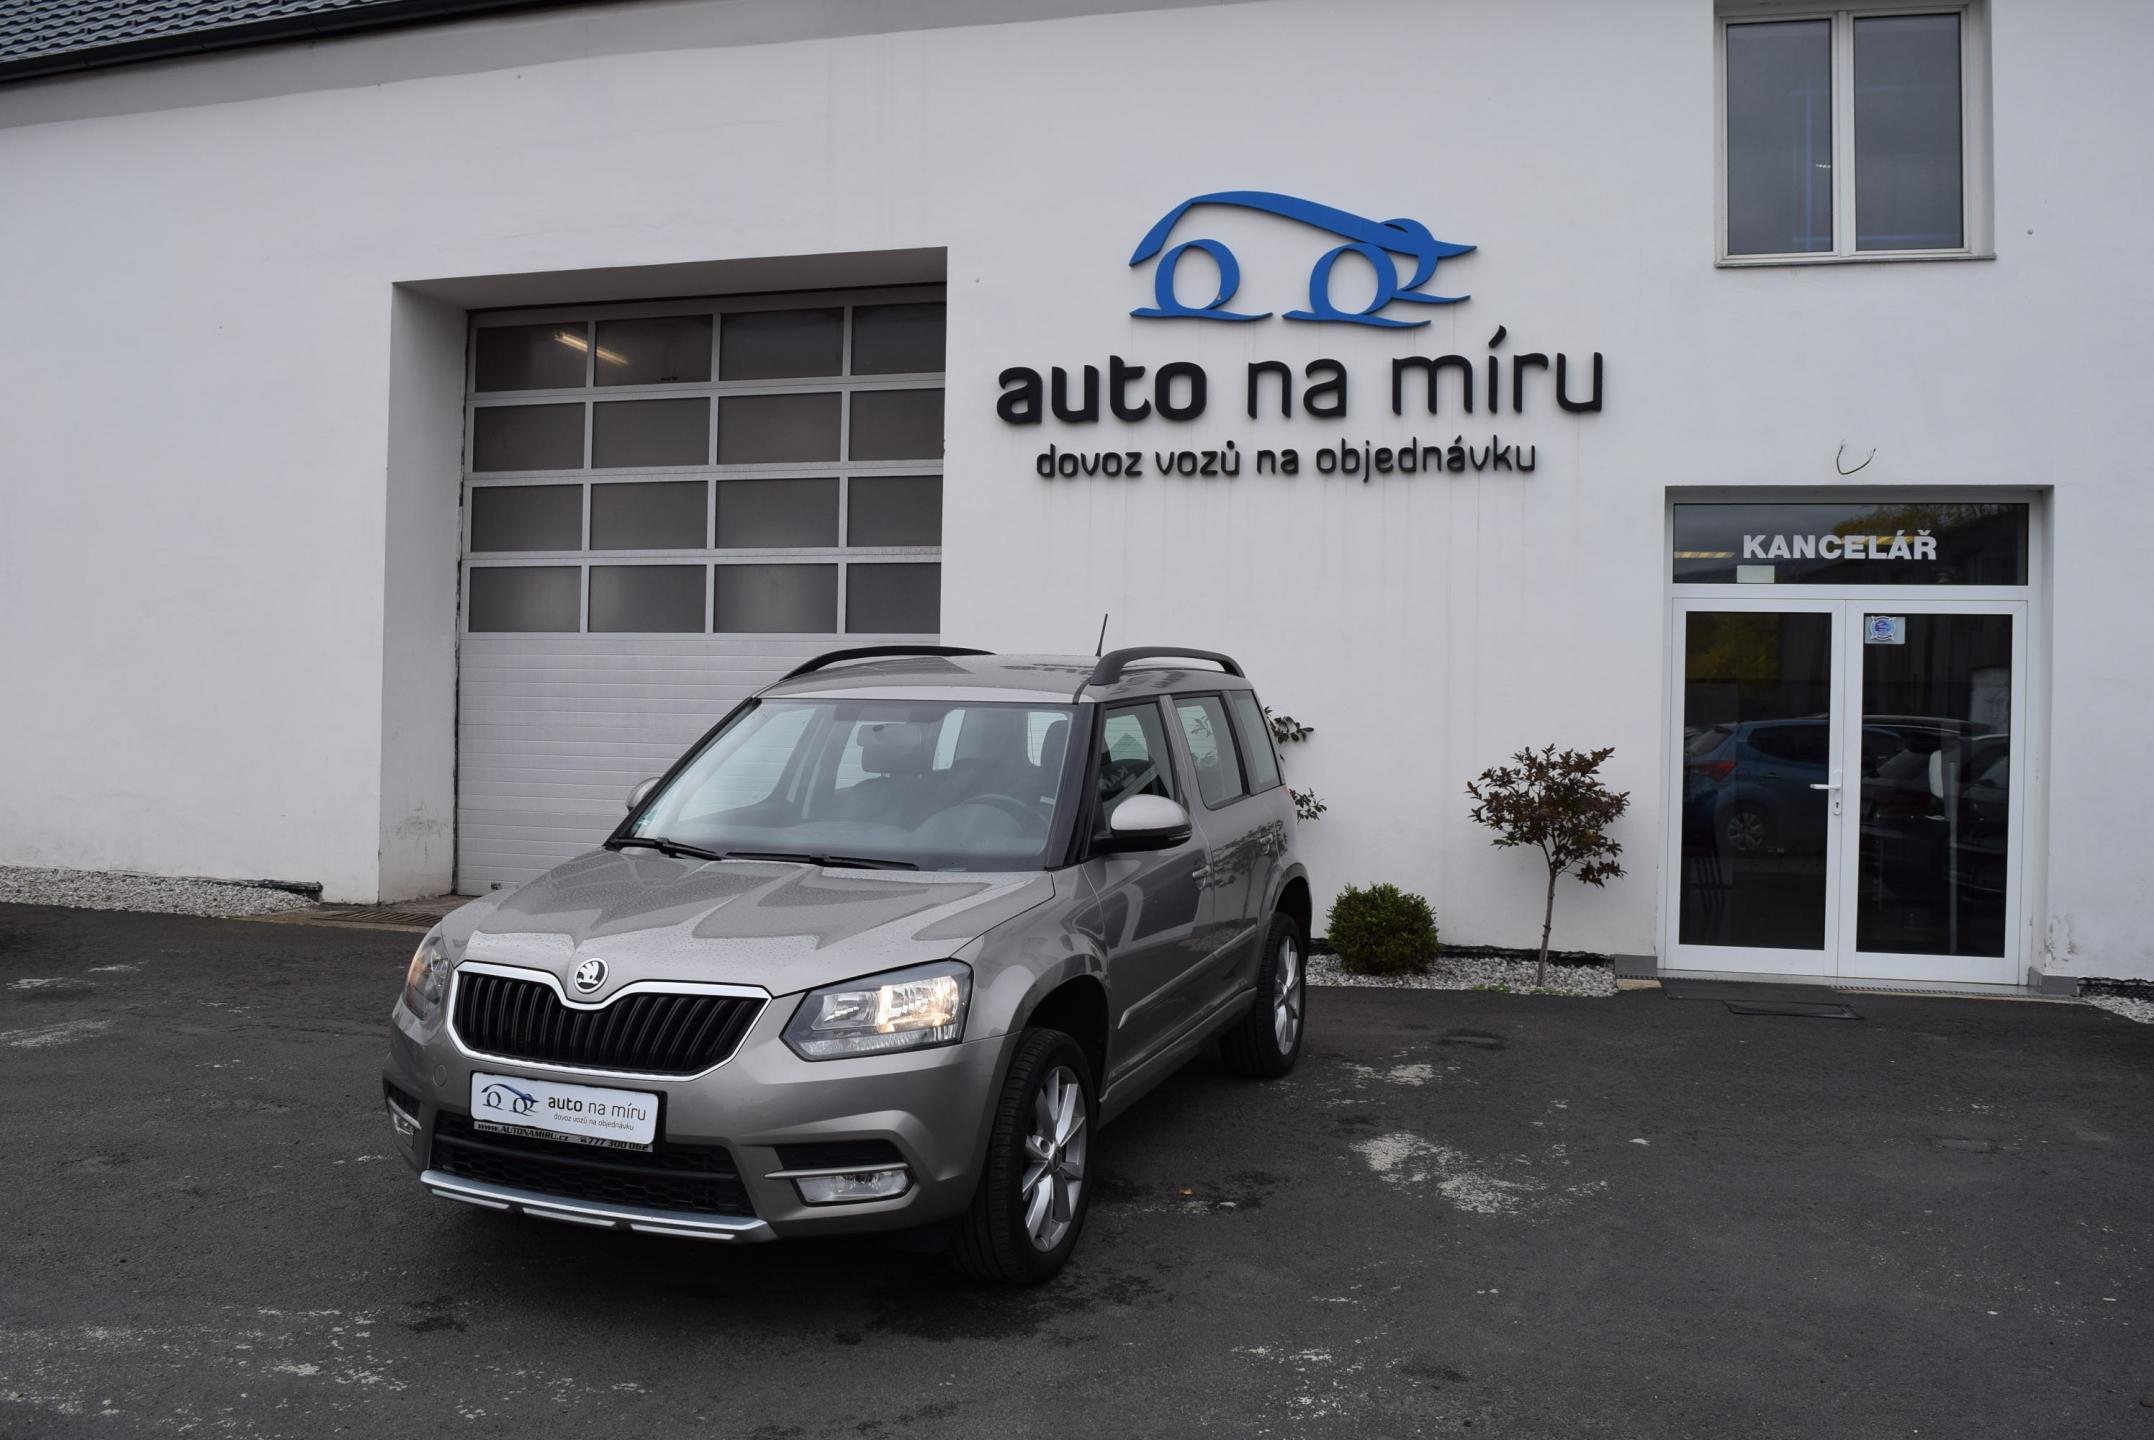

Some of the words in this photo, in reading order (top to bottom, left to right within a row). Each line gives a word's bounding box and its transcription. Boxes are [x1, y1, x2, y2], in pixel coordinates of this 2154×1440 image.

[997, 354, 1208, 425] auto
[1247, 358, 1348, 420] na
[1391, 325, 1604, 416] míru
[1036, 443, 1143, 480] dovoz
[1155, 440, 1241, 478] vozů
[1256, 448, 1300, 476] na
[1315, 435, 1537, 484] objednávku
[1743, 528, 1938, 560] KANCELÁŘ
[547, 1096, 584, 1113] auto
[587, 1102, 607, 1116] na
[611, 1102, 647, 1121] míru
[553, 1113, 572, 1123] dovoz
[588, 1119, 597, 1127] na
